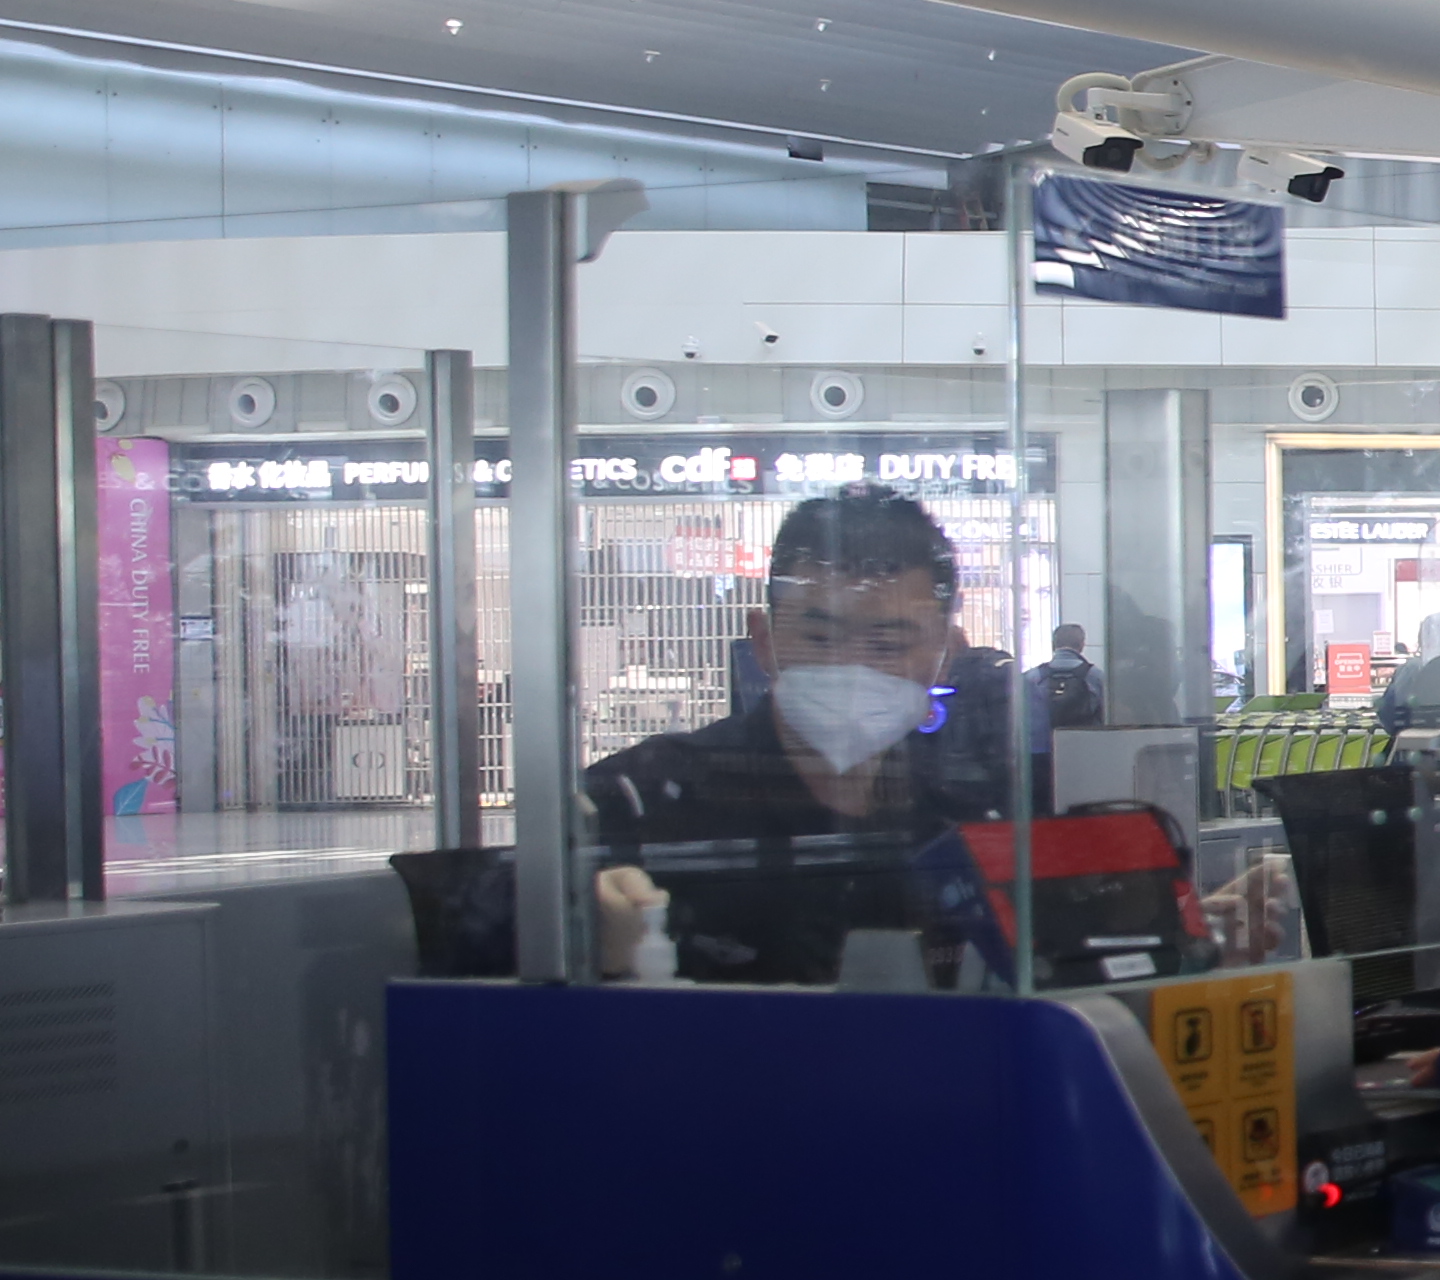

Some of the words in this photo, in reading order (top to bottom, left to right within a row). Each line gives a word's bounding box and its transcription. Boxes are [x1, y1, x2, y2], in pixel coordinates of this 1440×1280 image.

[879, 454, 955, 480] DUTY
[129, 498, 148, 562] CHINA
[131, 570, 149, 621] DUTY
[133, 629, 150, 673] FREE
